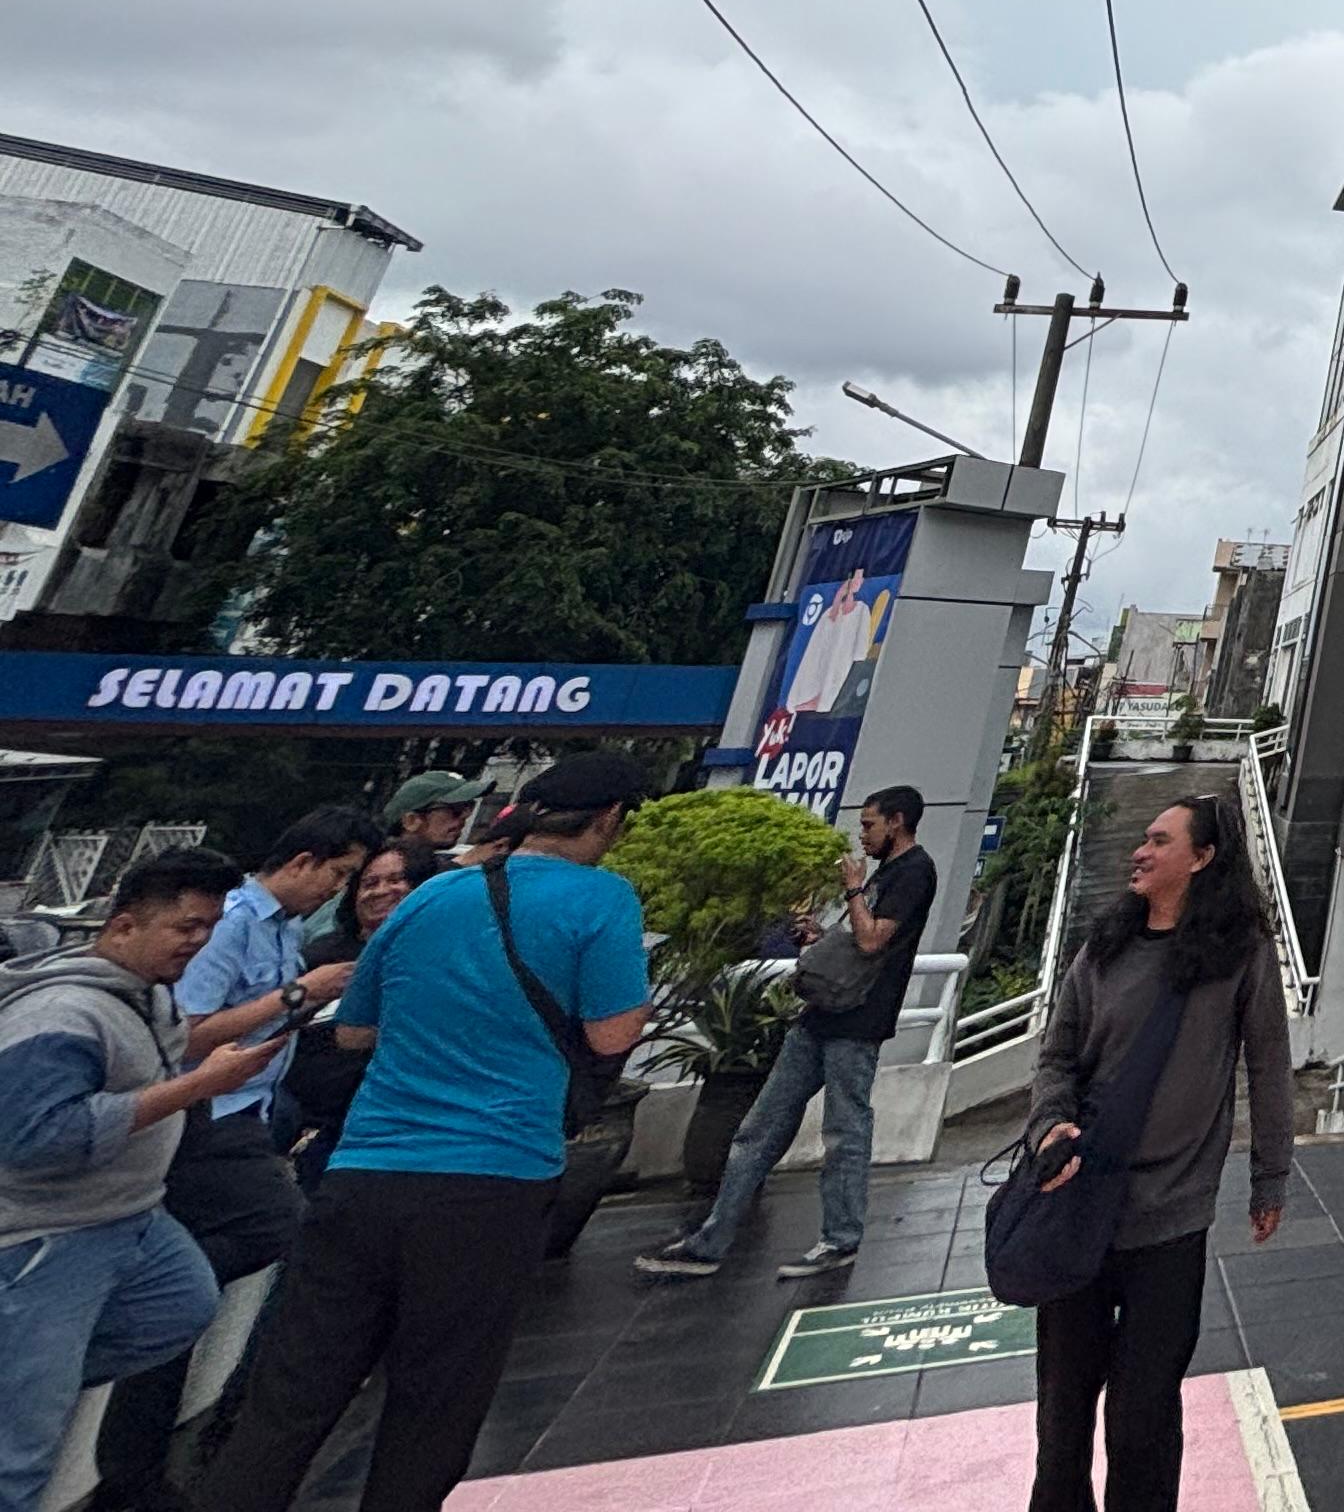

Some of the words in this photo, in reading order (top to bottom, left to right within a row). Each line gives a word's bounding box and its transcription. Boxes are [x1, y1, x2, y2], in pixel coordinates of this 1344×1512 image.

[87, 667, 354, 711] SELAMAT
[363, 673, 593, 715] DATANG
[753, 751, 845, 790] LAPOR
